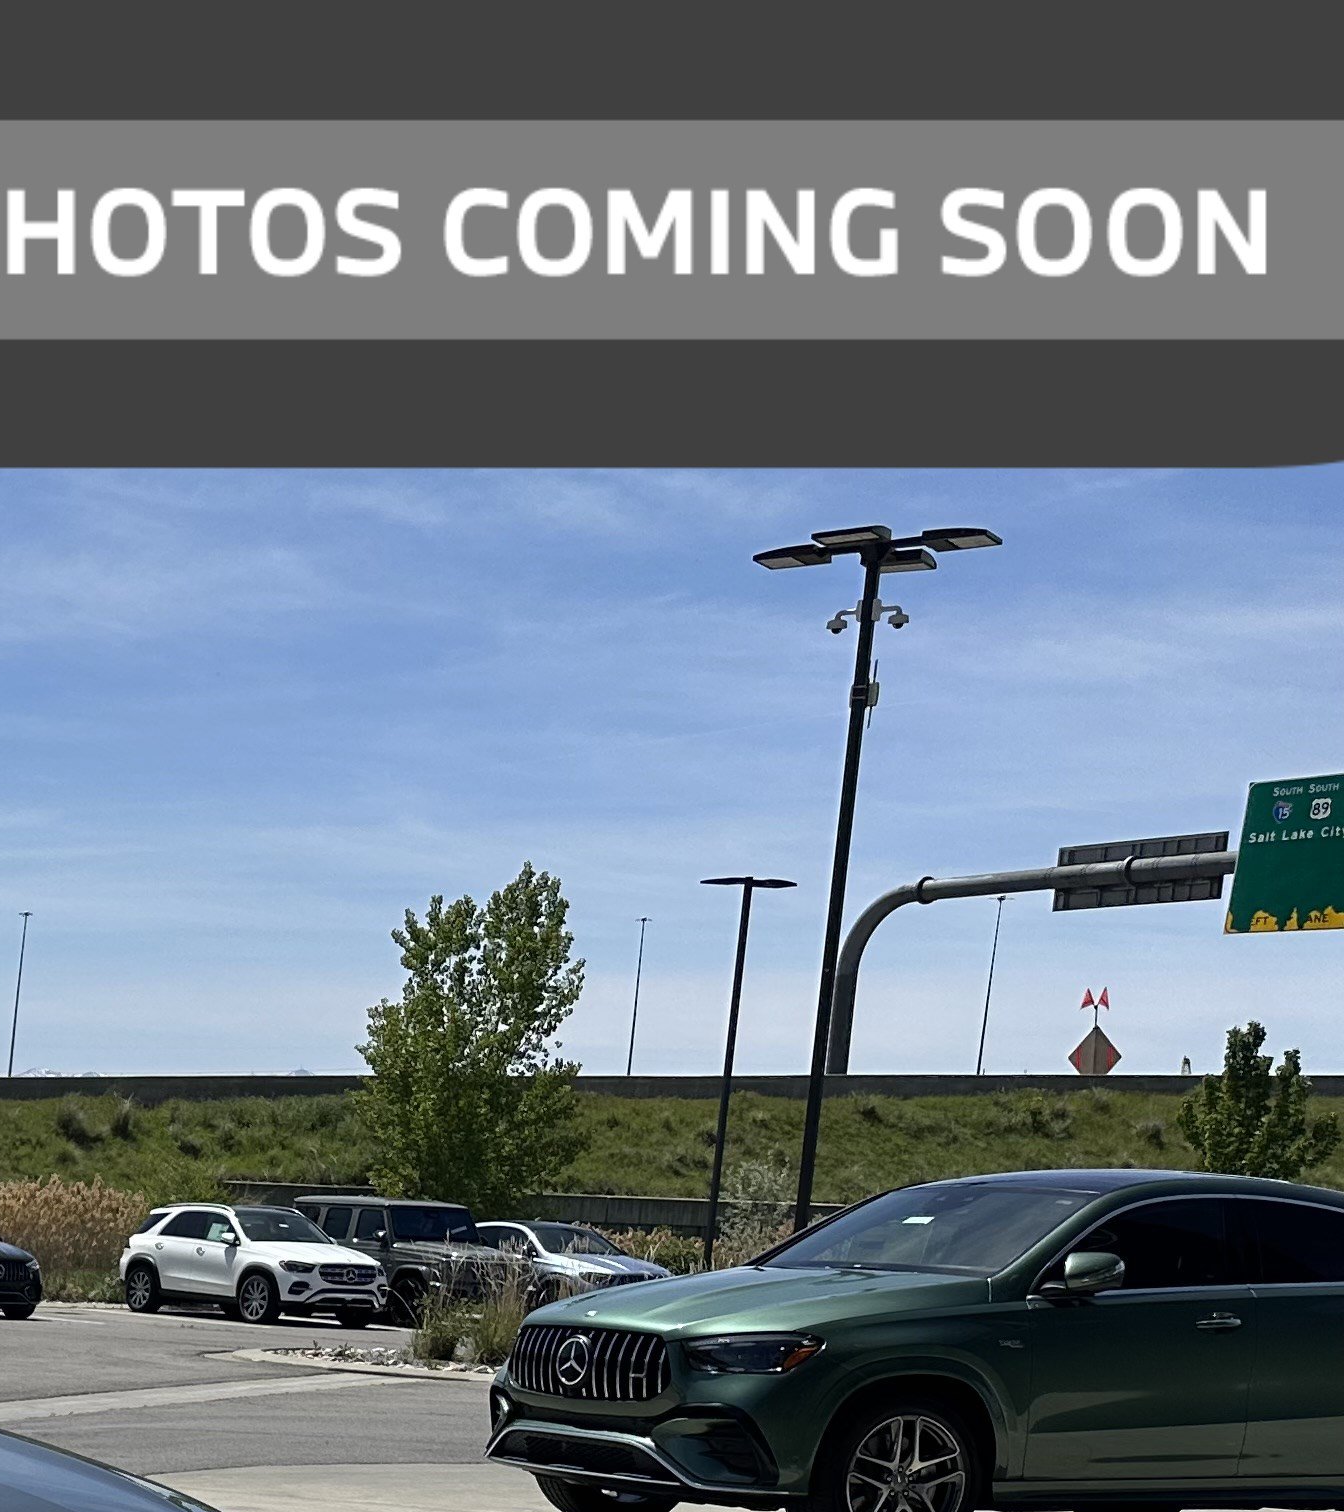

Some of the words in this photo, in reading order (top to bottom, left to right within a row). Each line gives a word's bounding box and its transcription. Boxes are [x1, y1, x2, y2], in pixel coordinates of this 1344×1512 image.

[1278, 807, 1290, 819] 15
[1312, 802, 1330, 816] 89
[1248, 831, 1276, 843] Salt
[1281, 829, 1314, 841] Lake
